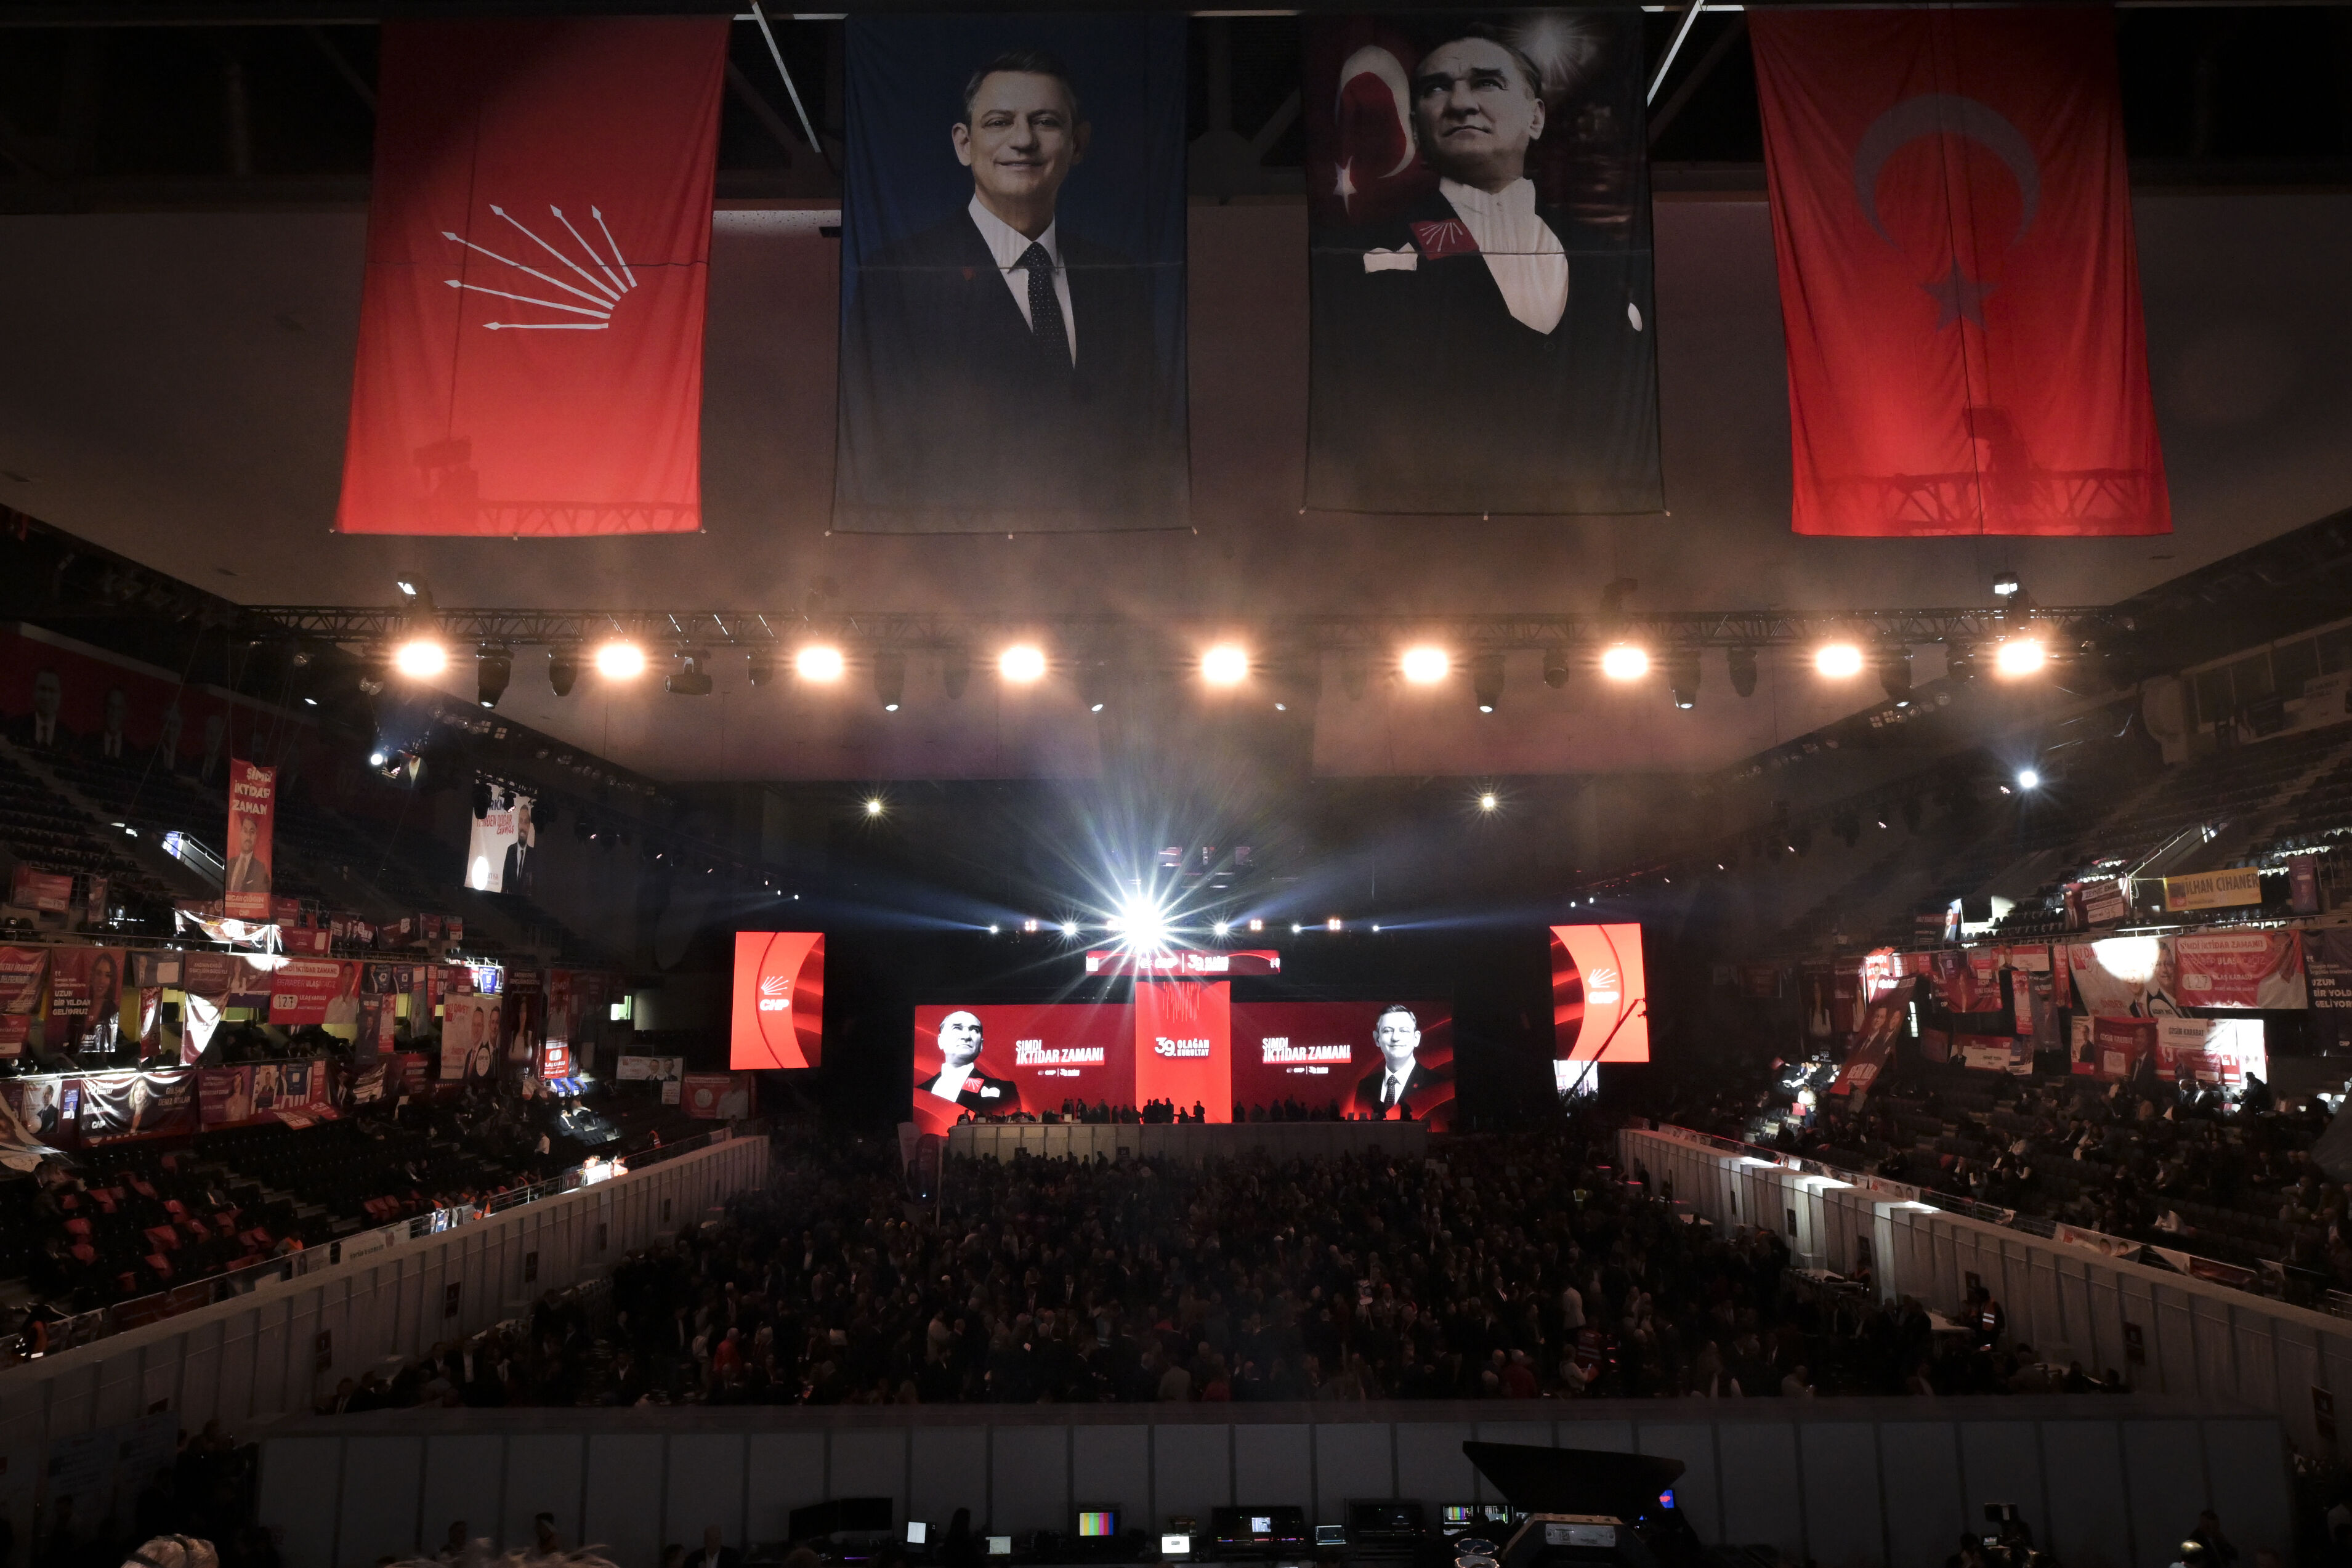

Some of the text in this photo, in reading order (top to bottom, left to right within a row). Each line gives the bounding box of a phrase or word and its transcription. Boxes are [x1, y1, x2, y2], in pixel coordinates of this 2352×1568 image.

[2185, 873, 2260, 895] İLHAN CİHANER
[53, 998, 65, 1006] BİR
[278, 995, 294, 1008] 127
[759, 999, 790, 1011] CHP
[1154, 1037, 1210, 1057] 39. OLAĞAN
[1177, 1048, 1210, 1057] KURULTAY
[1307, 1045, 1351, 1061] ZAMANI
[1061, 1047, 1104, 1062] ZAMANI
[91, 1120, 106, 1130] CHP
